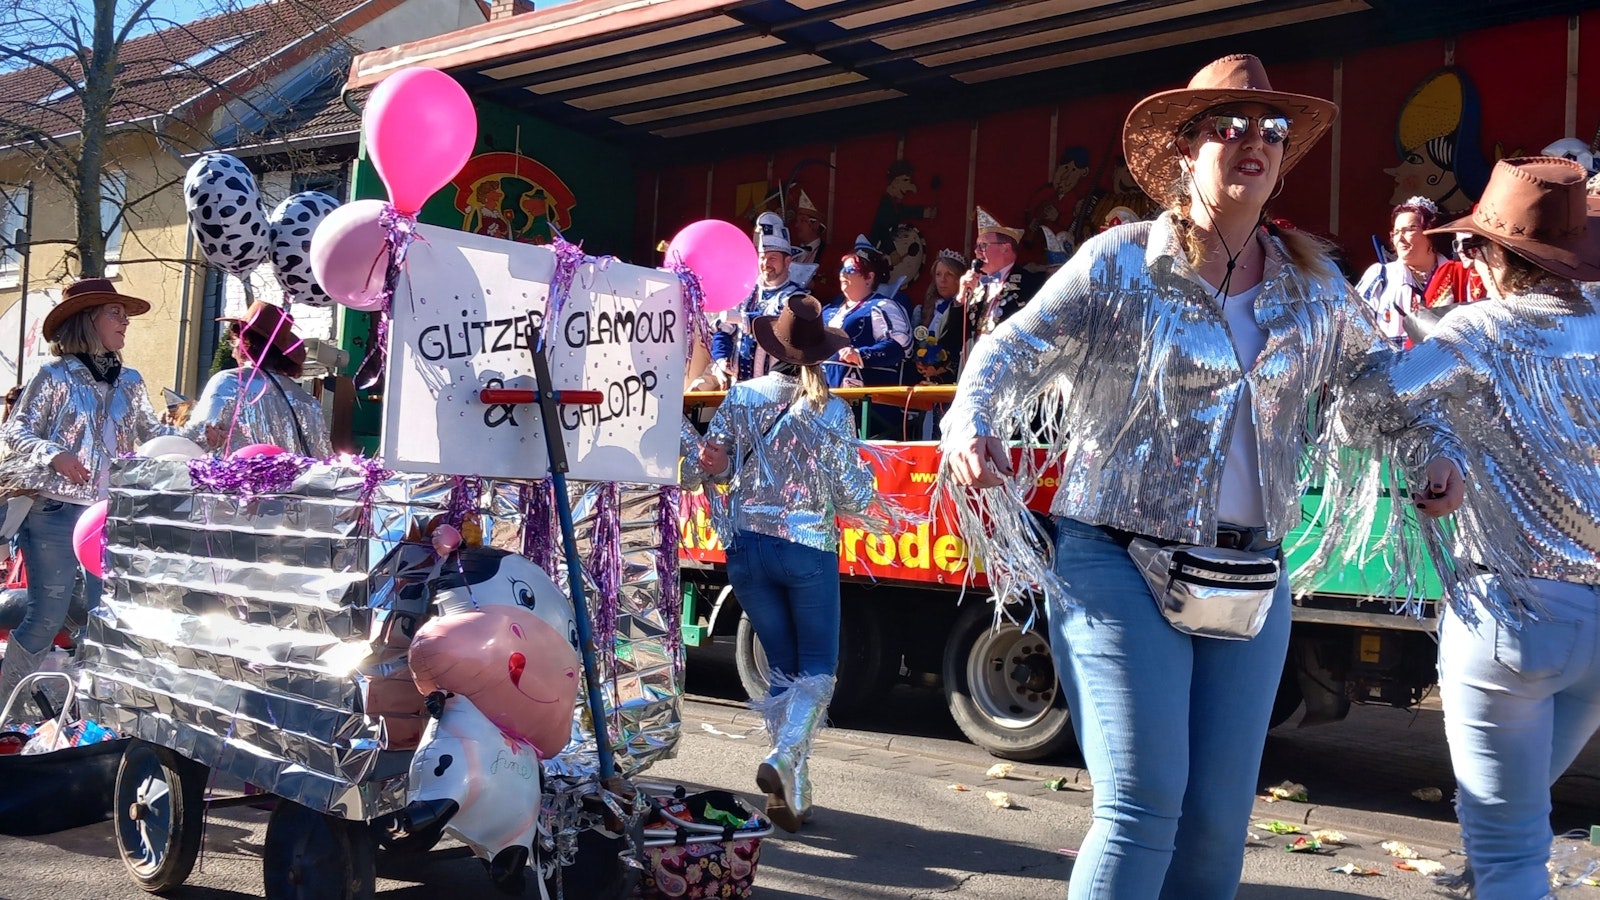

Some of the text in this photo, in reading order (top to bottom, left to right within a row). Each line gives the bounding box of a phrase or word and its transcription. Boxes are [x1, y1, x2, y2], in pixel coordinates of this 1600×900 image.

[565, 309, 676, 348] GLAMOUR
[483, 370, 658, 430] & GALOPP
[838, 519, 986, 574] rode
